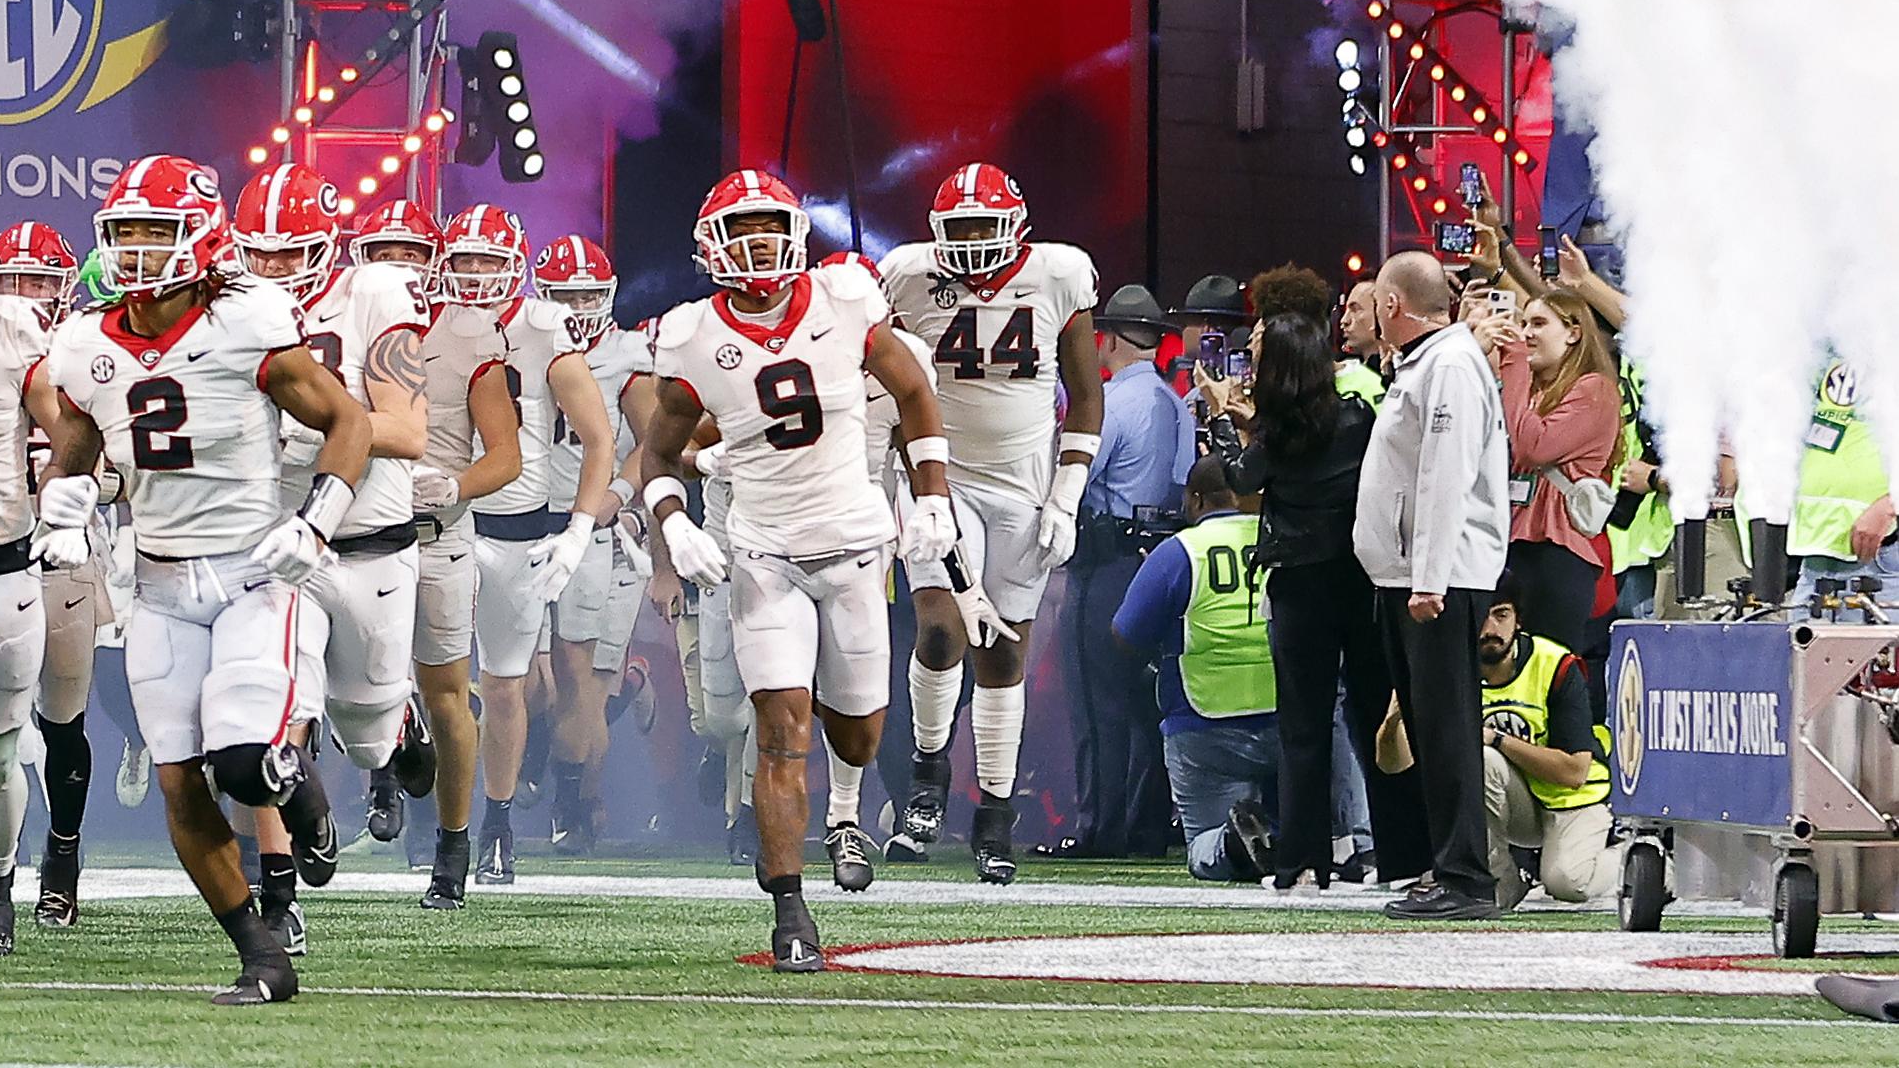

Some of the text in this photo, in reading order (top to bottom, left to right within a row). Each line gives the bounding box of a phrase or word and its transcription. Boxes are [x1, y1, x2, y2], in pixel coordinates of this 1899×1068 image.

[187, 170, 221, 202] G
[140, 349, 161, 366] G
[764, 335, 786, 351] G
[935, 307, 1040, 380] 44
[126, 376, 195, 471] 2
[756, 359, 824, 451] 9
[1648, 690, 1787, 756] IT JUST MEANS MORE.
